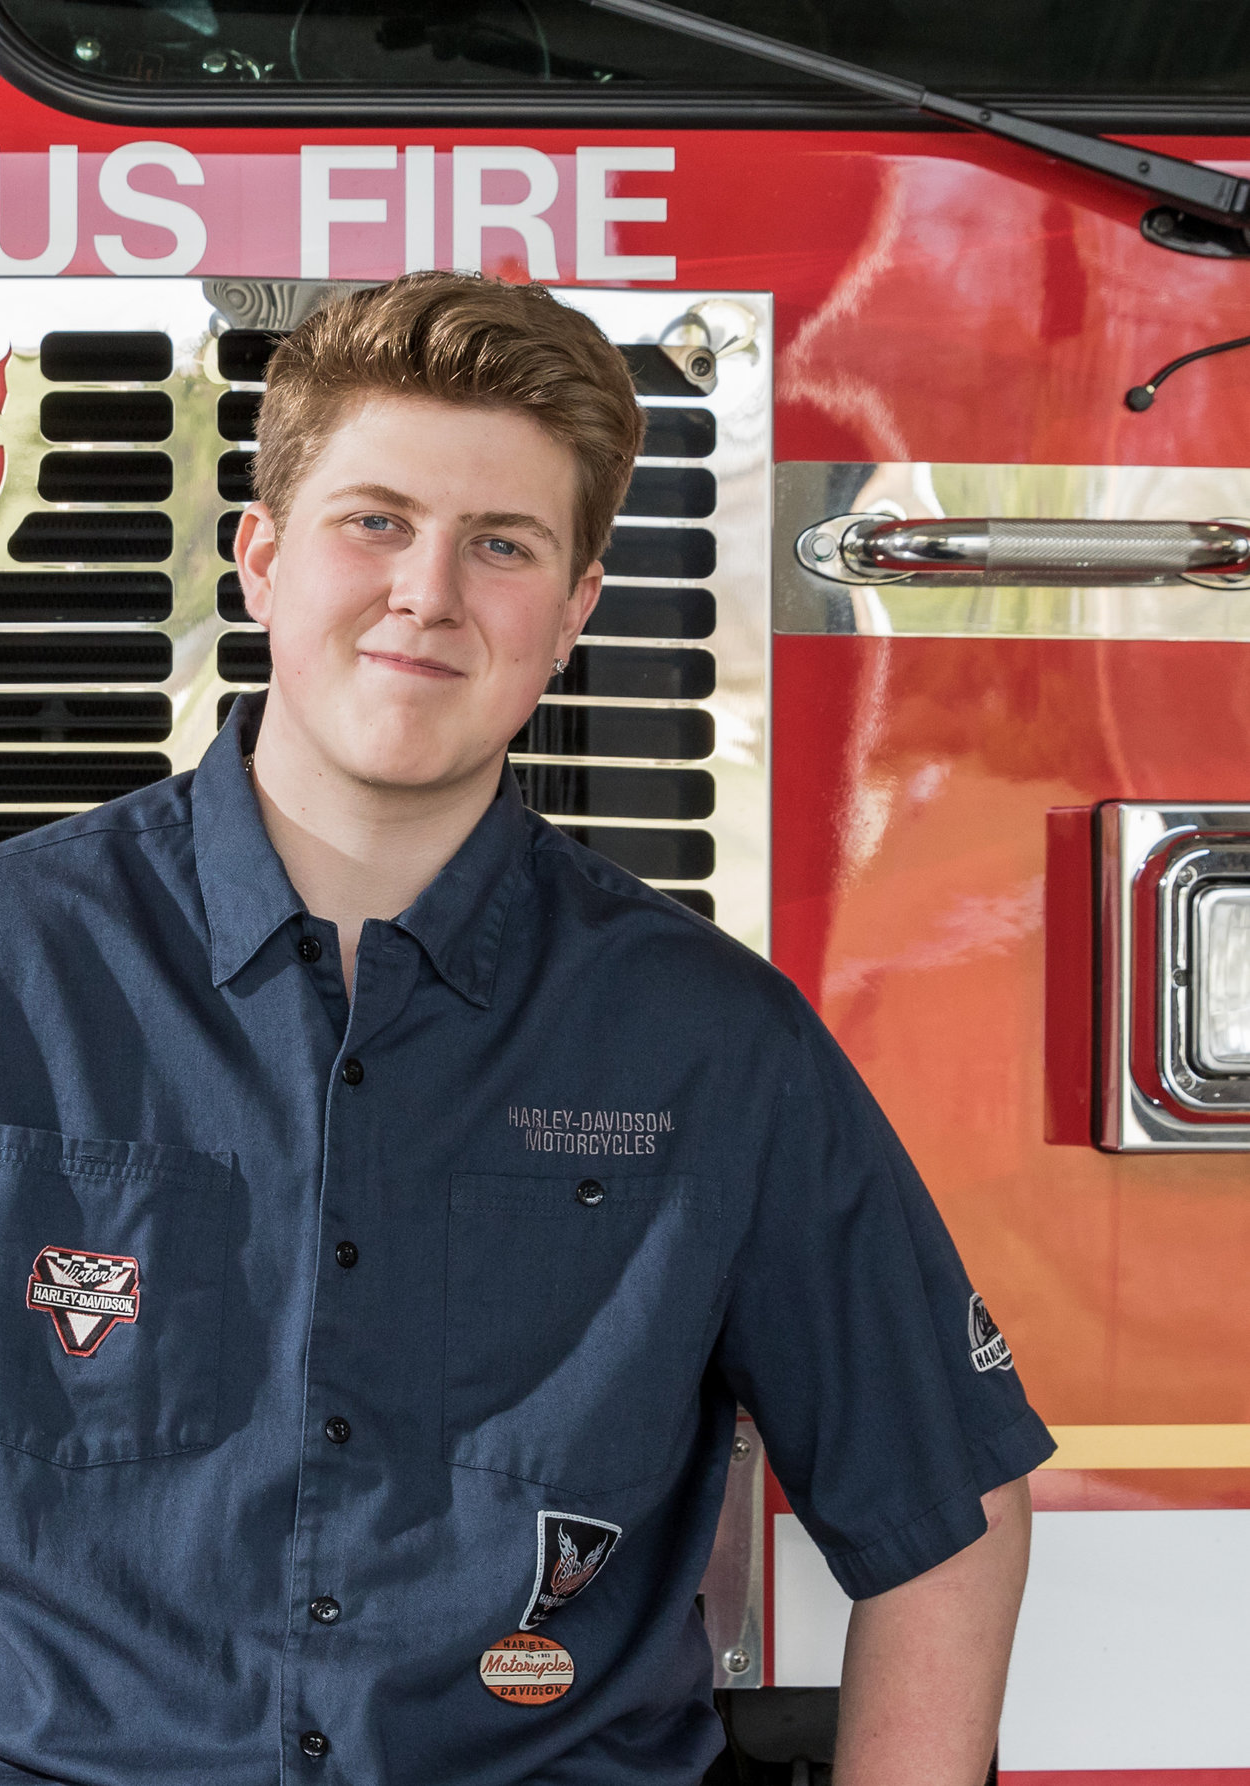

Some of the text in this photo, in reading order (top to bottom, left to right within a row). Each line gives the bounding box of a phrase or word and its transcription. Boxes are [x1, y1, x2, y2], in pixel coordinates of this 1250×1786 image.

[299, 144, 677, 282] FIRE
[525, 1129, 656, 1155] MOTORCYCLES
[61, 1262, 119, 1283] Victory
[481, 1653, 574, 1680] Motorcycles
